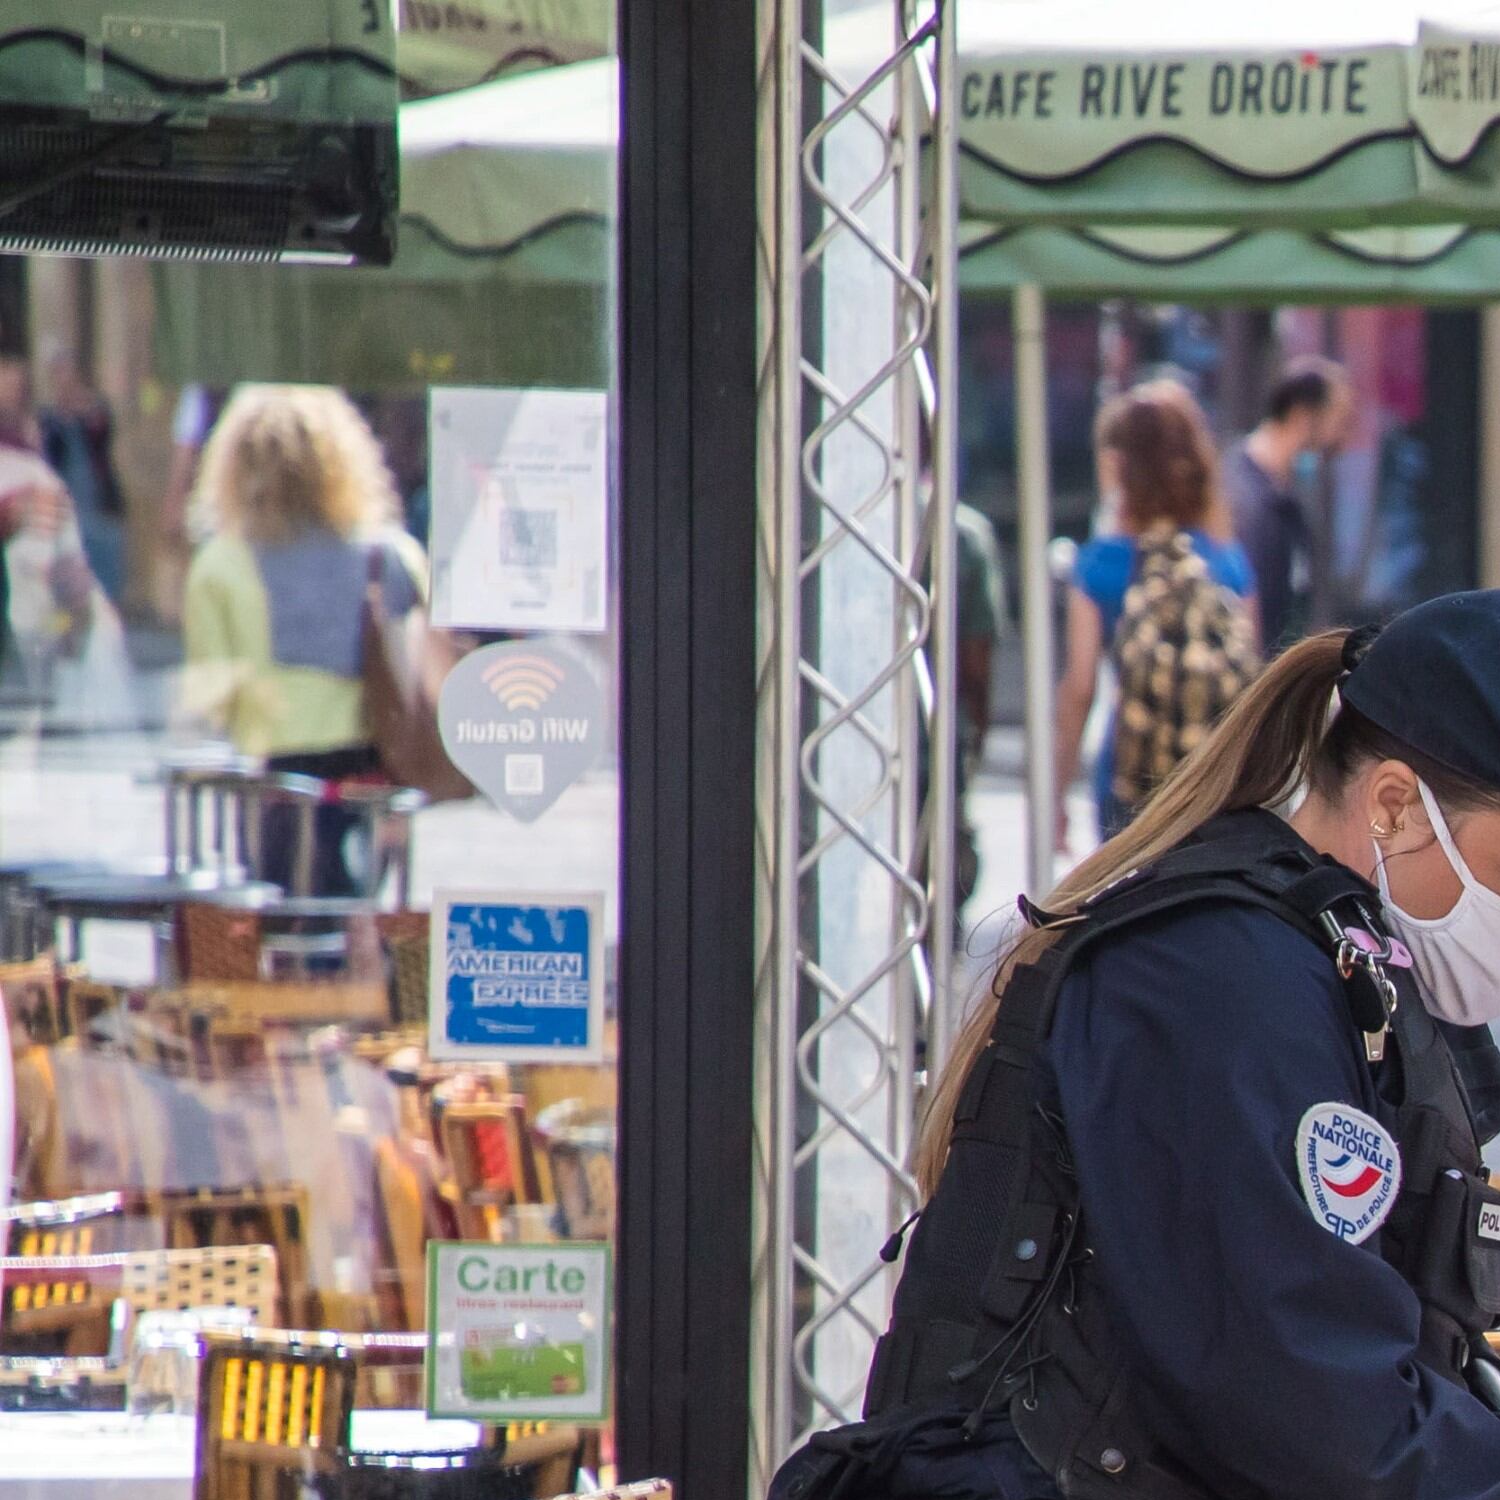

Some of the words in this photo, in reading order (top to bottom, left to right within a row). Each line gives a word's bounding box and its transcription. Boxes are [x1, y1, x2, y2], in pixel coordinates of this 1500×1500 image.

[961, 71, 1055, 119] CAFE
[1081, 62, 1185, 118] RIVE
[448, 954, 578, 974] AMERICAN
[1312, 1120, 1393, 1173] NATIONALE
[1332, 1114, 1381, 1150] POLICE
[1307, 1136, 1329, 1214] PREFECTURE
[1356, 1212, 1370, 1230] DE
[1368, 1176, 1393, 1217] POLICE
[457, 1255, 586, 1294] Carte
